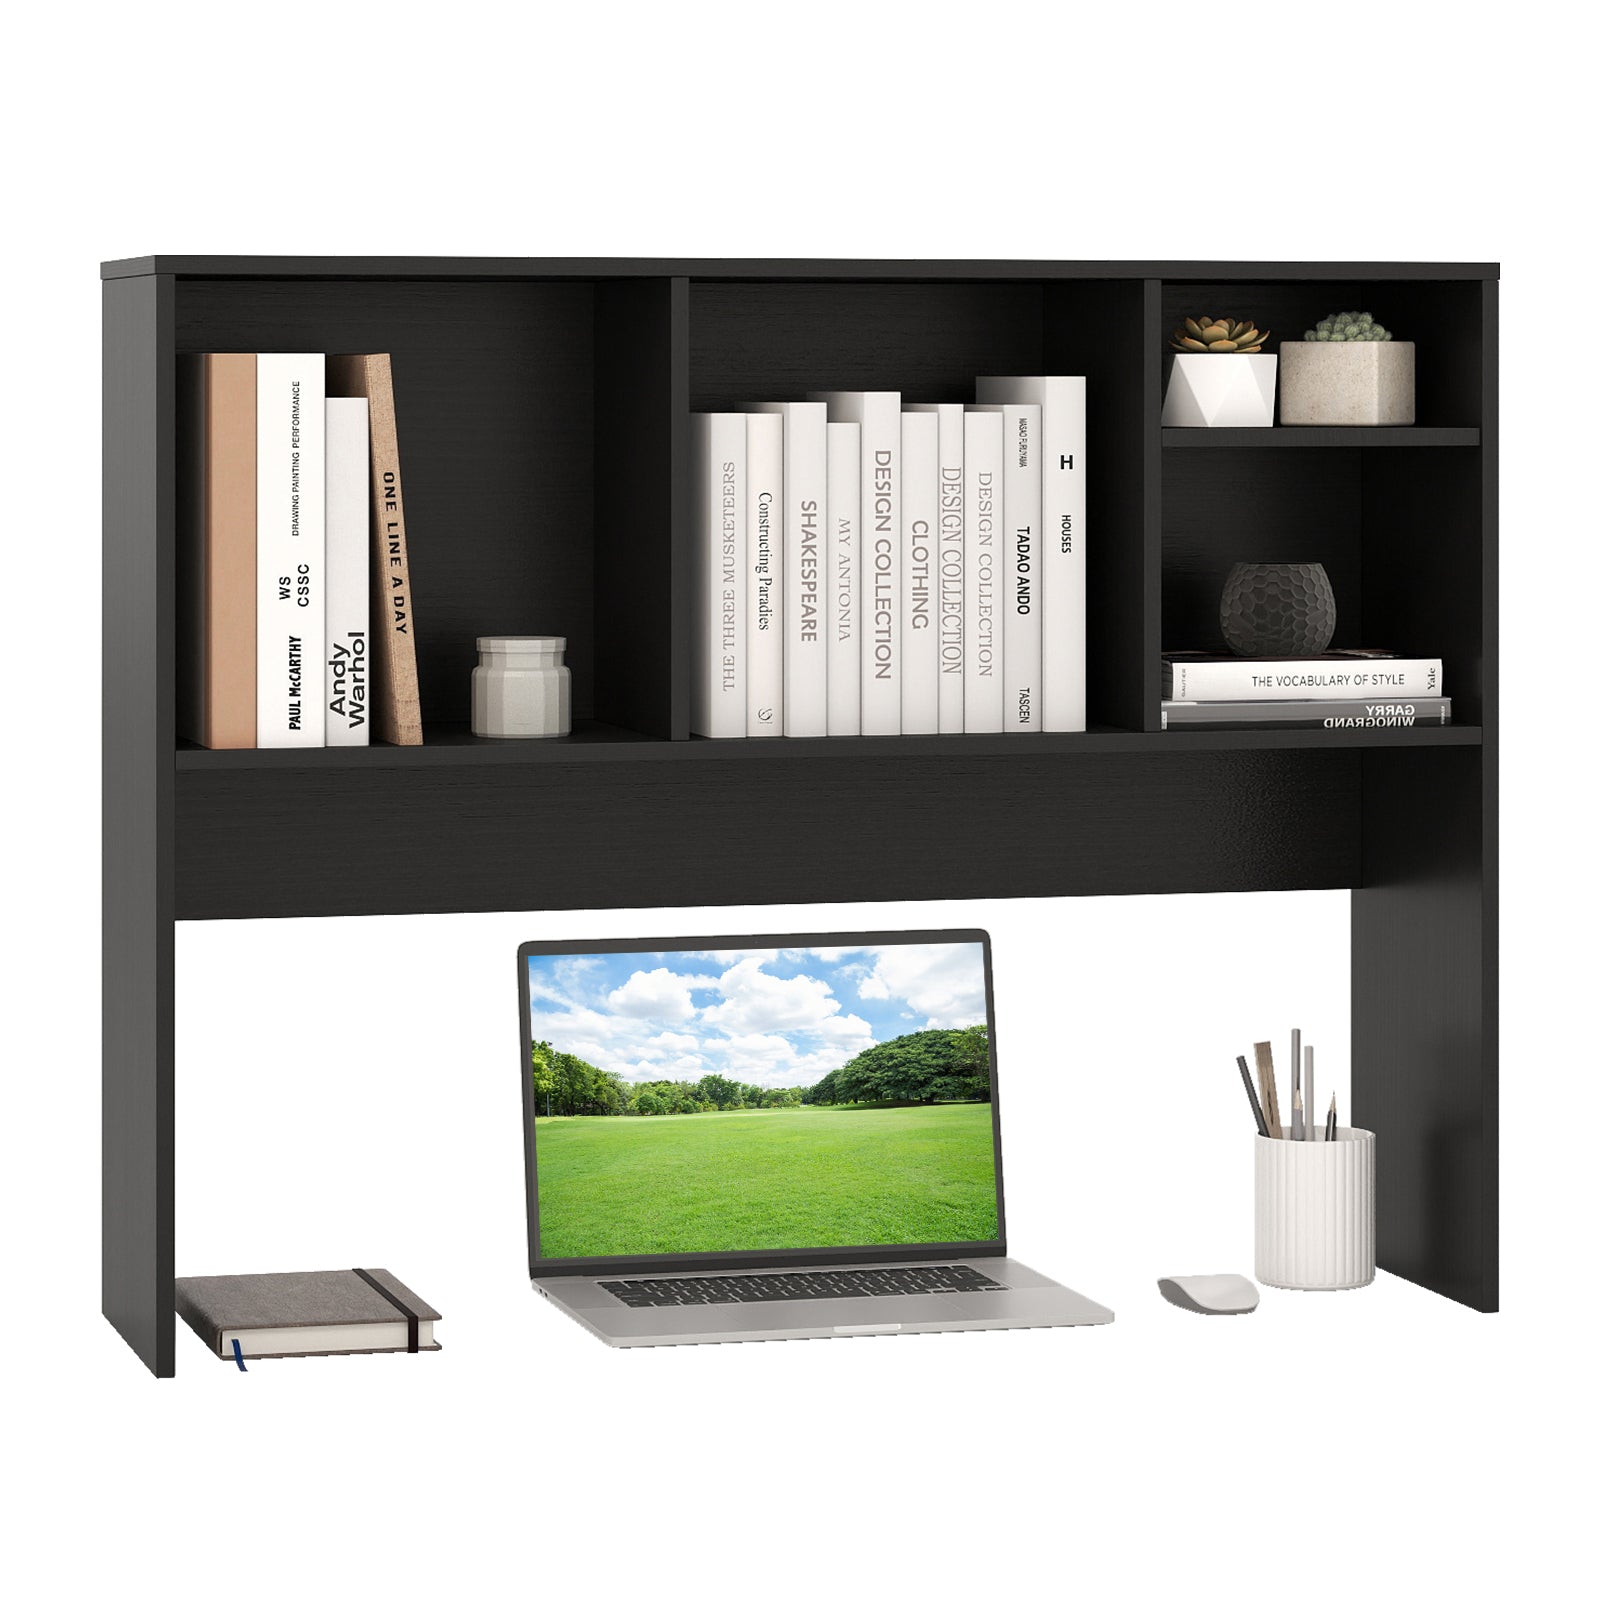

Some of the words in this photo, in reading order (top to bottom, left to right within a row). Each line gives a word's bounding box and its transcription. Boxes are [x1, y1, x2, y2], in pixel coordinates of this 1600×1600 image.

[292, 381, 300, 449] PERFORMANCE
[1060, 455, 1073, 470] H
[383, 471, 397, 512] ONE
[875, 450, 891, 532] DESIGN
[942, 467, 961, 543] DESIGN
[978, 472, 992, 547] DESIGN
[387, 522, 401, 567] LINE
[723, 461, 735, 583] MUSKETEERS
[755, 492, 773, 574] Constructing
[838, 518, 851, 546] MY
[1061, 514, 1071, 554] HOUSES
[801, 500, 817, 642] SHAKESPEARE
[912, 520, 929, 629] CLOTHING
[1017, 526, 1030, 573] TADAO
[279, 576, 291, 600] WS
[297, 564, 309, 607] CSSC
[392, 576, 403, 589] A
[758, 577, 773, 631] Paradies
[838, 553, 851, 643] ANTONIA
[875, 539, 891, 679] COLLECTION
[1017, 576, 1030, 615] ANDO
[394, 596, 407, 634] DAY
[723, 589, 735, 650] THREE
[942, 549, 961, 674] COLLECTION
[978, 553, 992, 677] COLLECTION
[289, 636, 301, 697] McCARTHY
[328, 643, 350, 716] Andy
[348, 632, 365, 728] Warhol
[723, 655, 735, 691] THE
[1252, 676, 1273, 687] THE
[1276, 675, 1351, 687] VOCABULARY
[1353, 675, 1369, 686] OF
[1371, 674, 1405, 686] STYLE
[1427, 667, 1436, 690] Yale
[289, 700, 301, 730] PAUL
[1018, 687, 1030, 724] TASCEN
